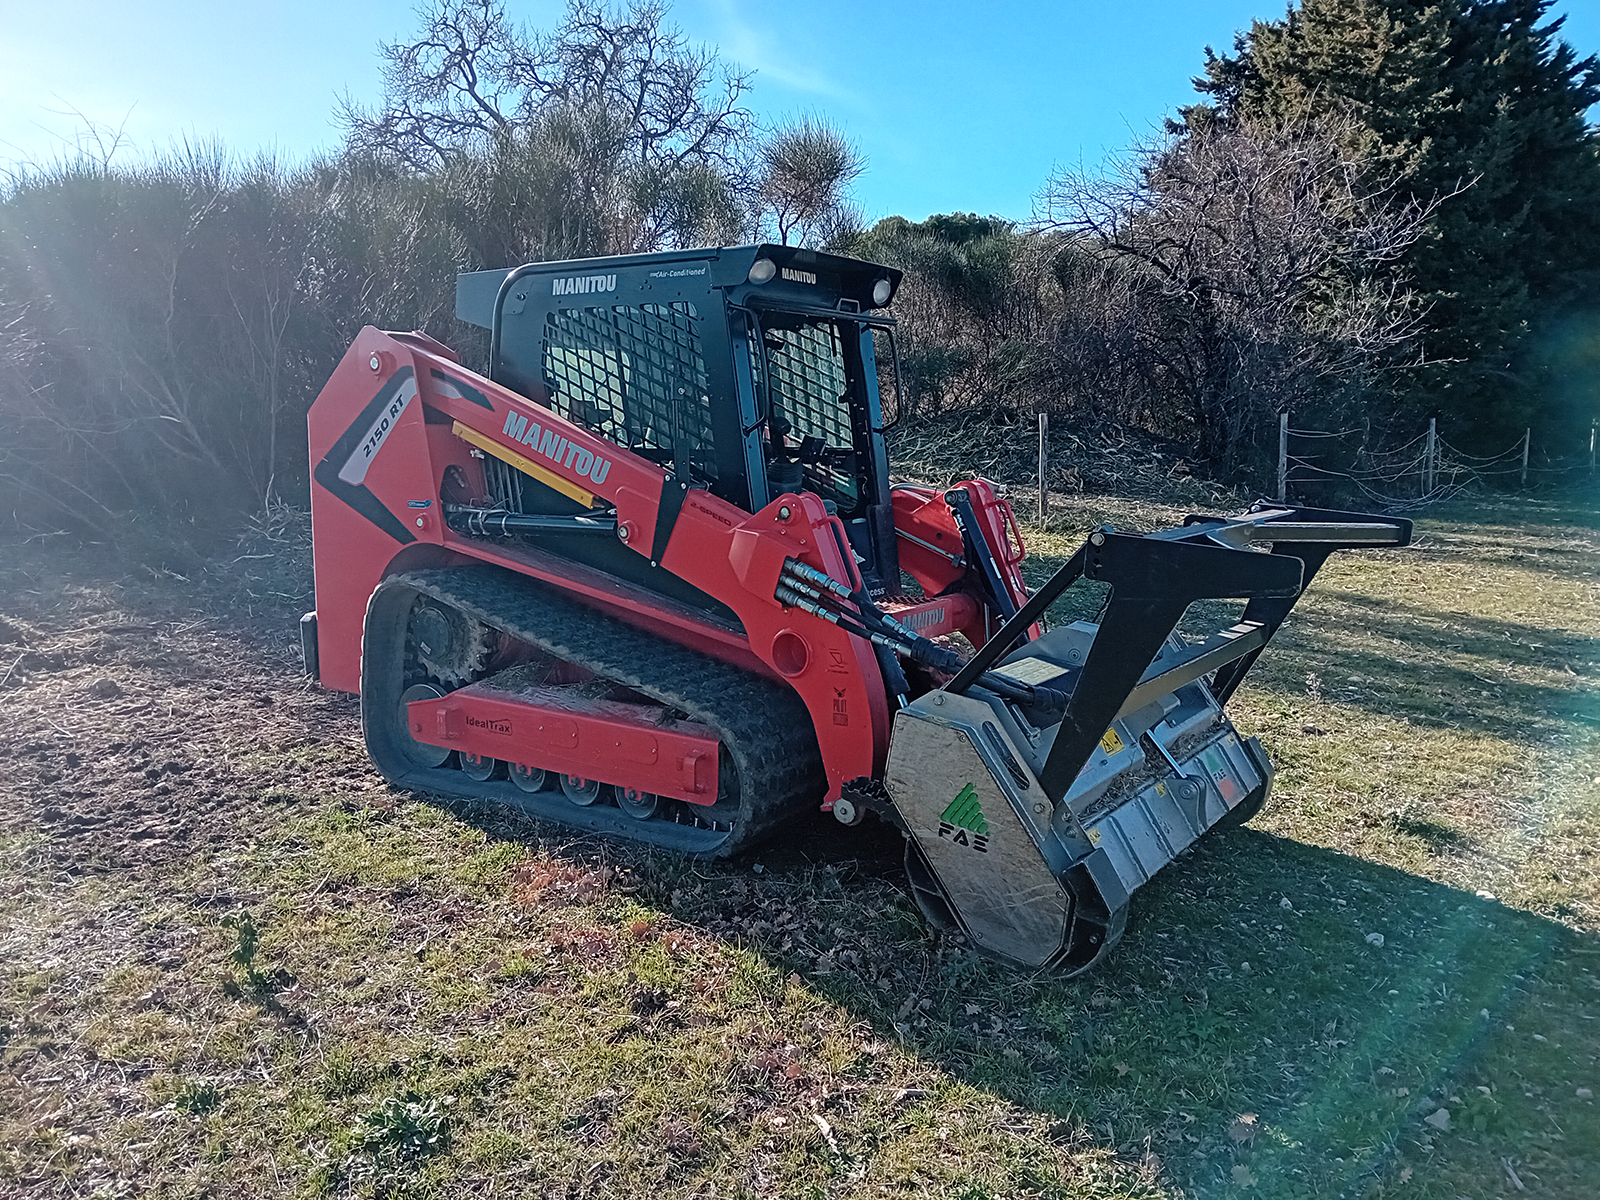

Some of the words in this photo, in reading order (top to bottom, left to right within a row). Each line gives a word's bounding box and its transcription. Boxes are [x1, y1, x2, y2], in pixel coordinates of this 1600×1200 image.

[552, 274, 617, 296] MANITOU
[781, 267, 817, 285] MANITOU
[363, 417, 389, 458] 2150
[389, 393, 404, 419] RT
[502, 409, 612, 485] MANITOU
[690, 501, 732, 527] 2-SPEED
[902, 607, 945, 631] MANITOU
[466, 715, 511, 734] IdealTrax
[1213, 768, 1227, 782] FAE
[938, 821, 990, 854] FAE
